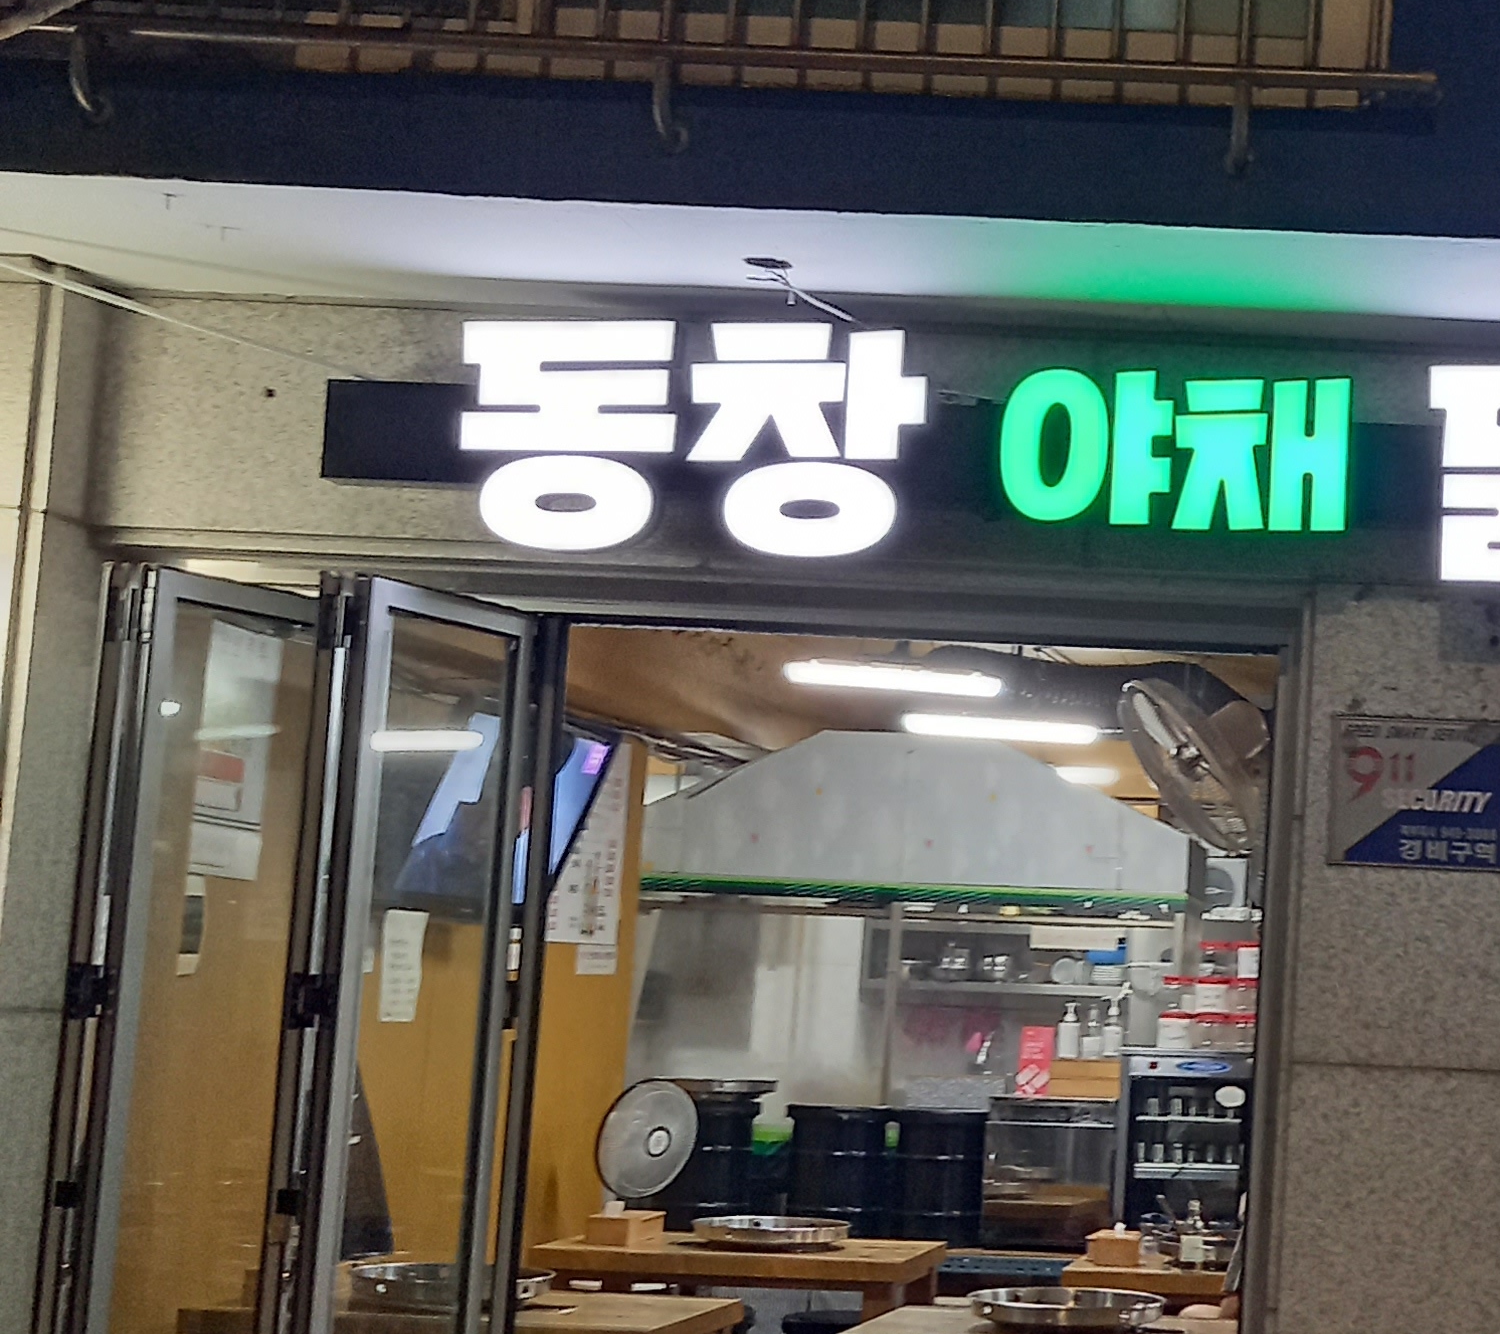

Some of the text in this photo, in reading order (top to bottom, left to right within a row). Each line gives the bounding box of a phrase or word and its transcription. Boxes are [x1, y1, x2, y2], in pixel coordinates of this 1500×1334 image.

[458, 318, 929, 559] 동창
[999, 366, 1351, 532] 야채
[1399, 838, 1498, 865] 경비구역
